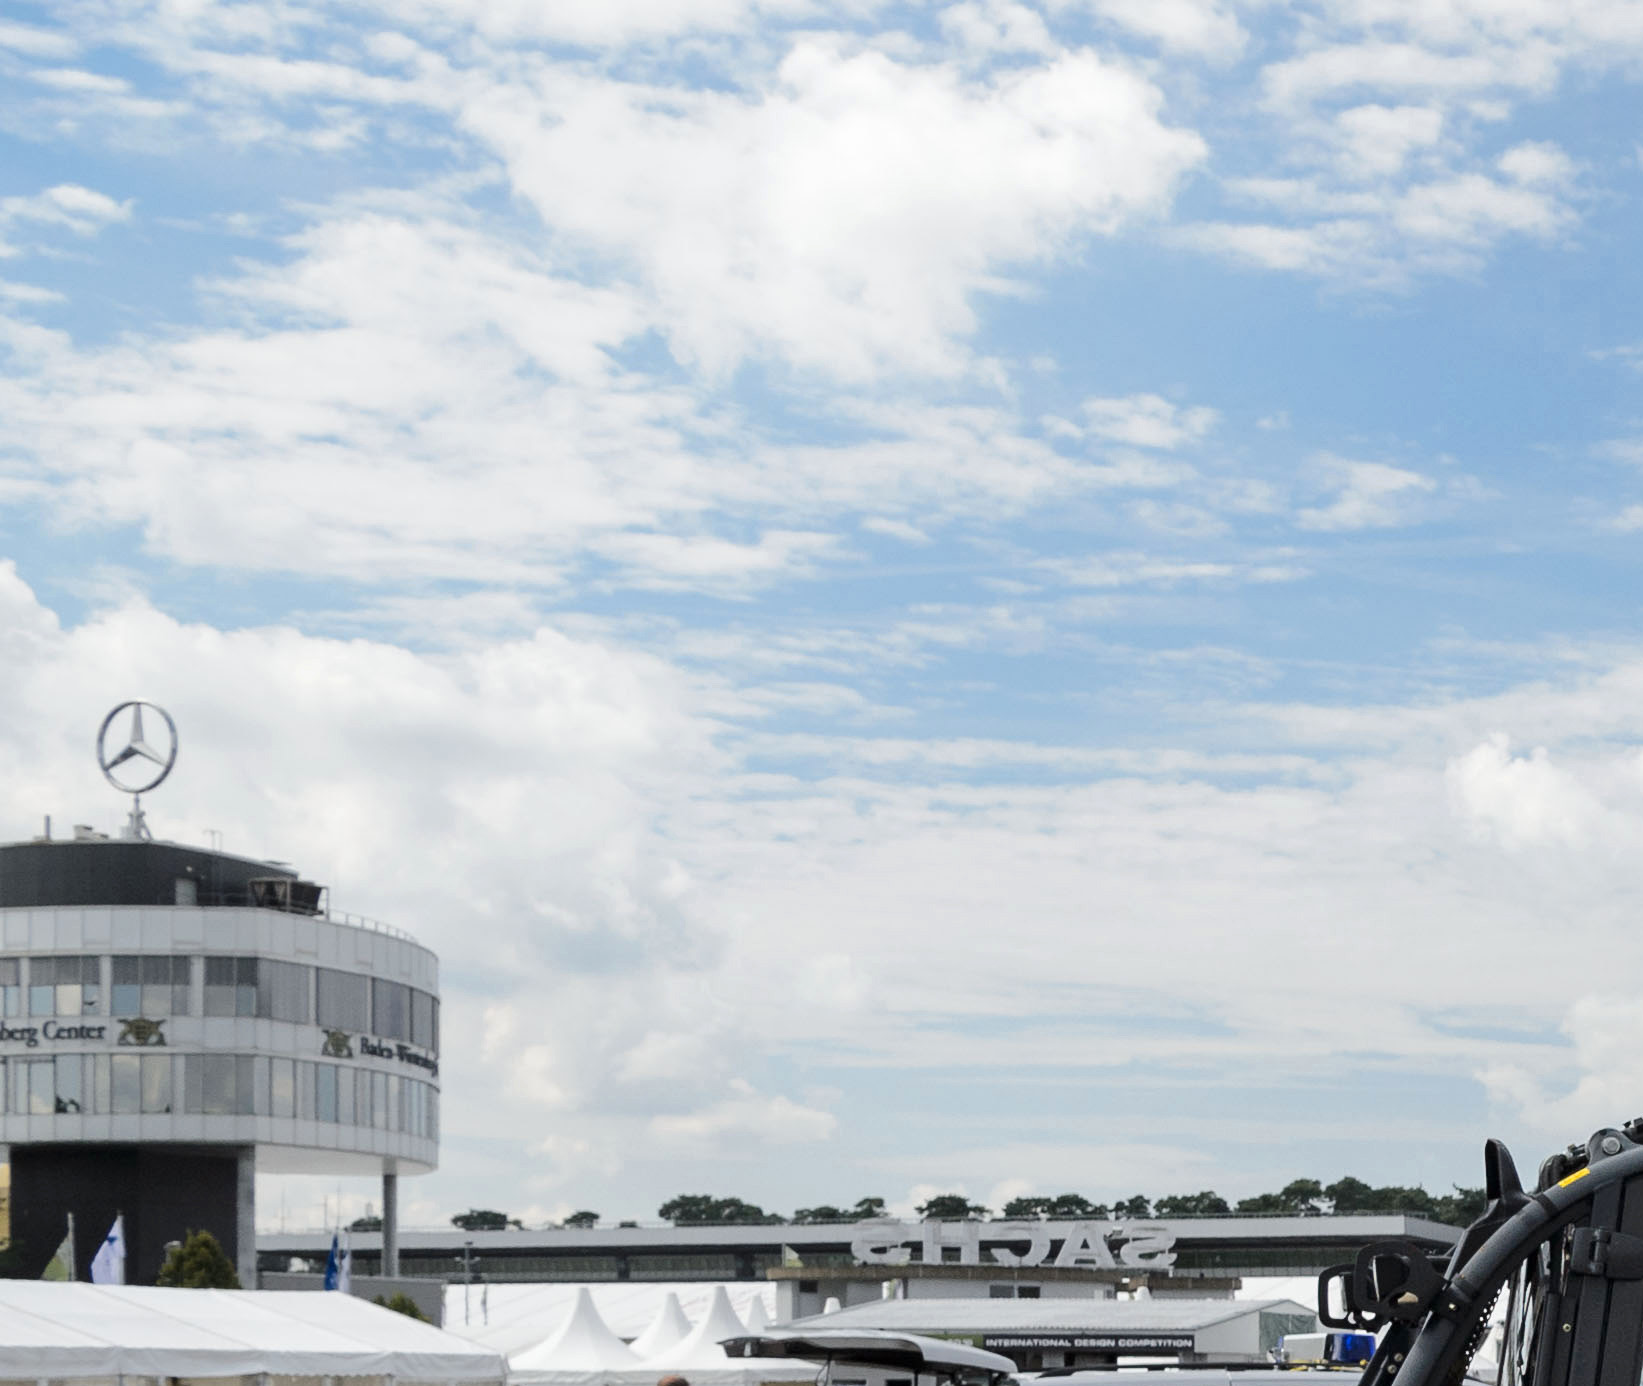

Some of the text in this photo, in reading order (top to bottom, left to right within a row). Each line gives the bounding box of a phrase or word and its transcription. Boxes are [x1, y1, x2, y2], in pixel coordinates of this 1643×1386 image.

[43, 1020, 106, 1040] Center
[985, 1338, 1193, 1348] INTERNATIONAL DESIGN COMPETITION
